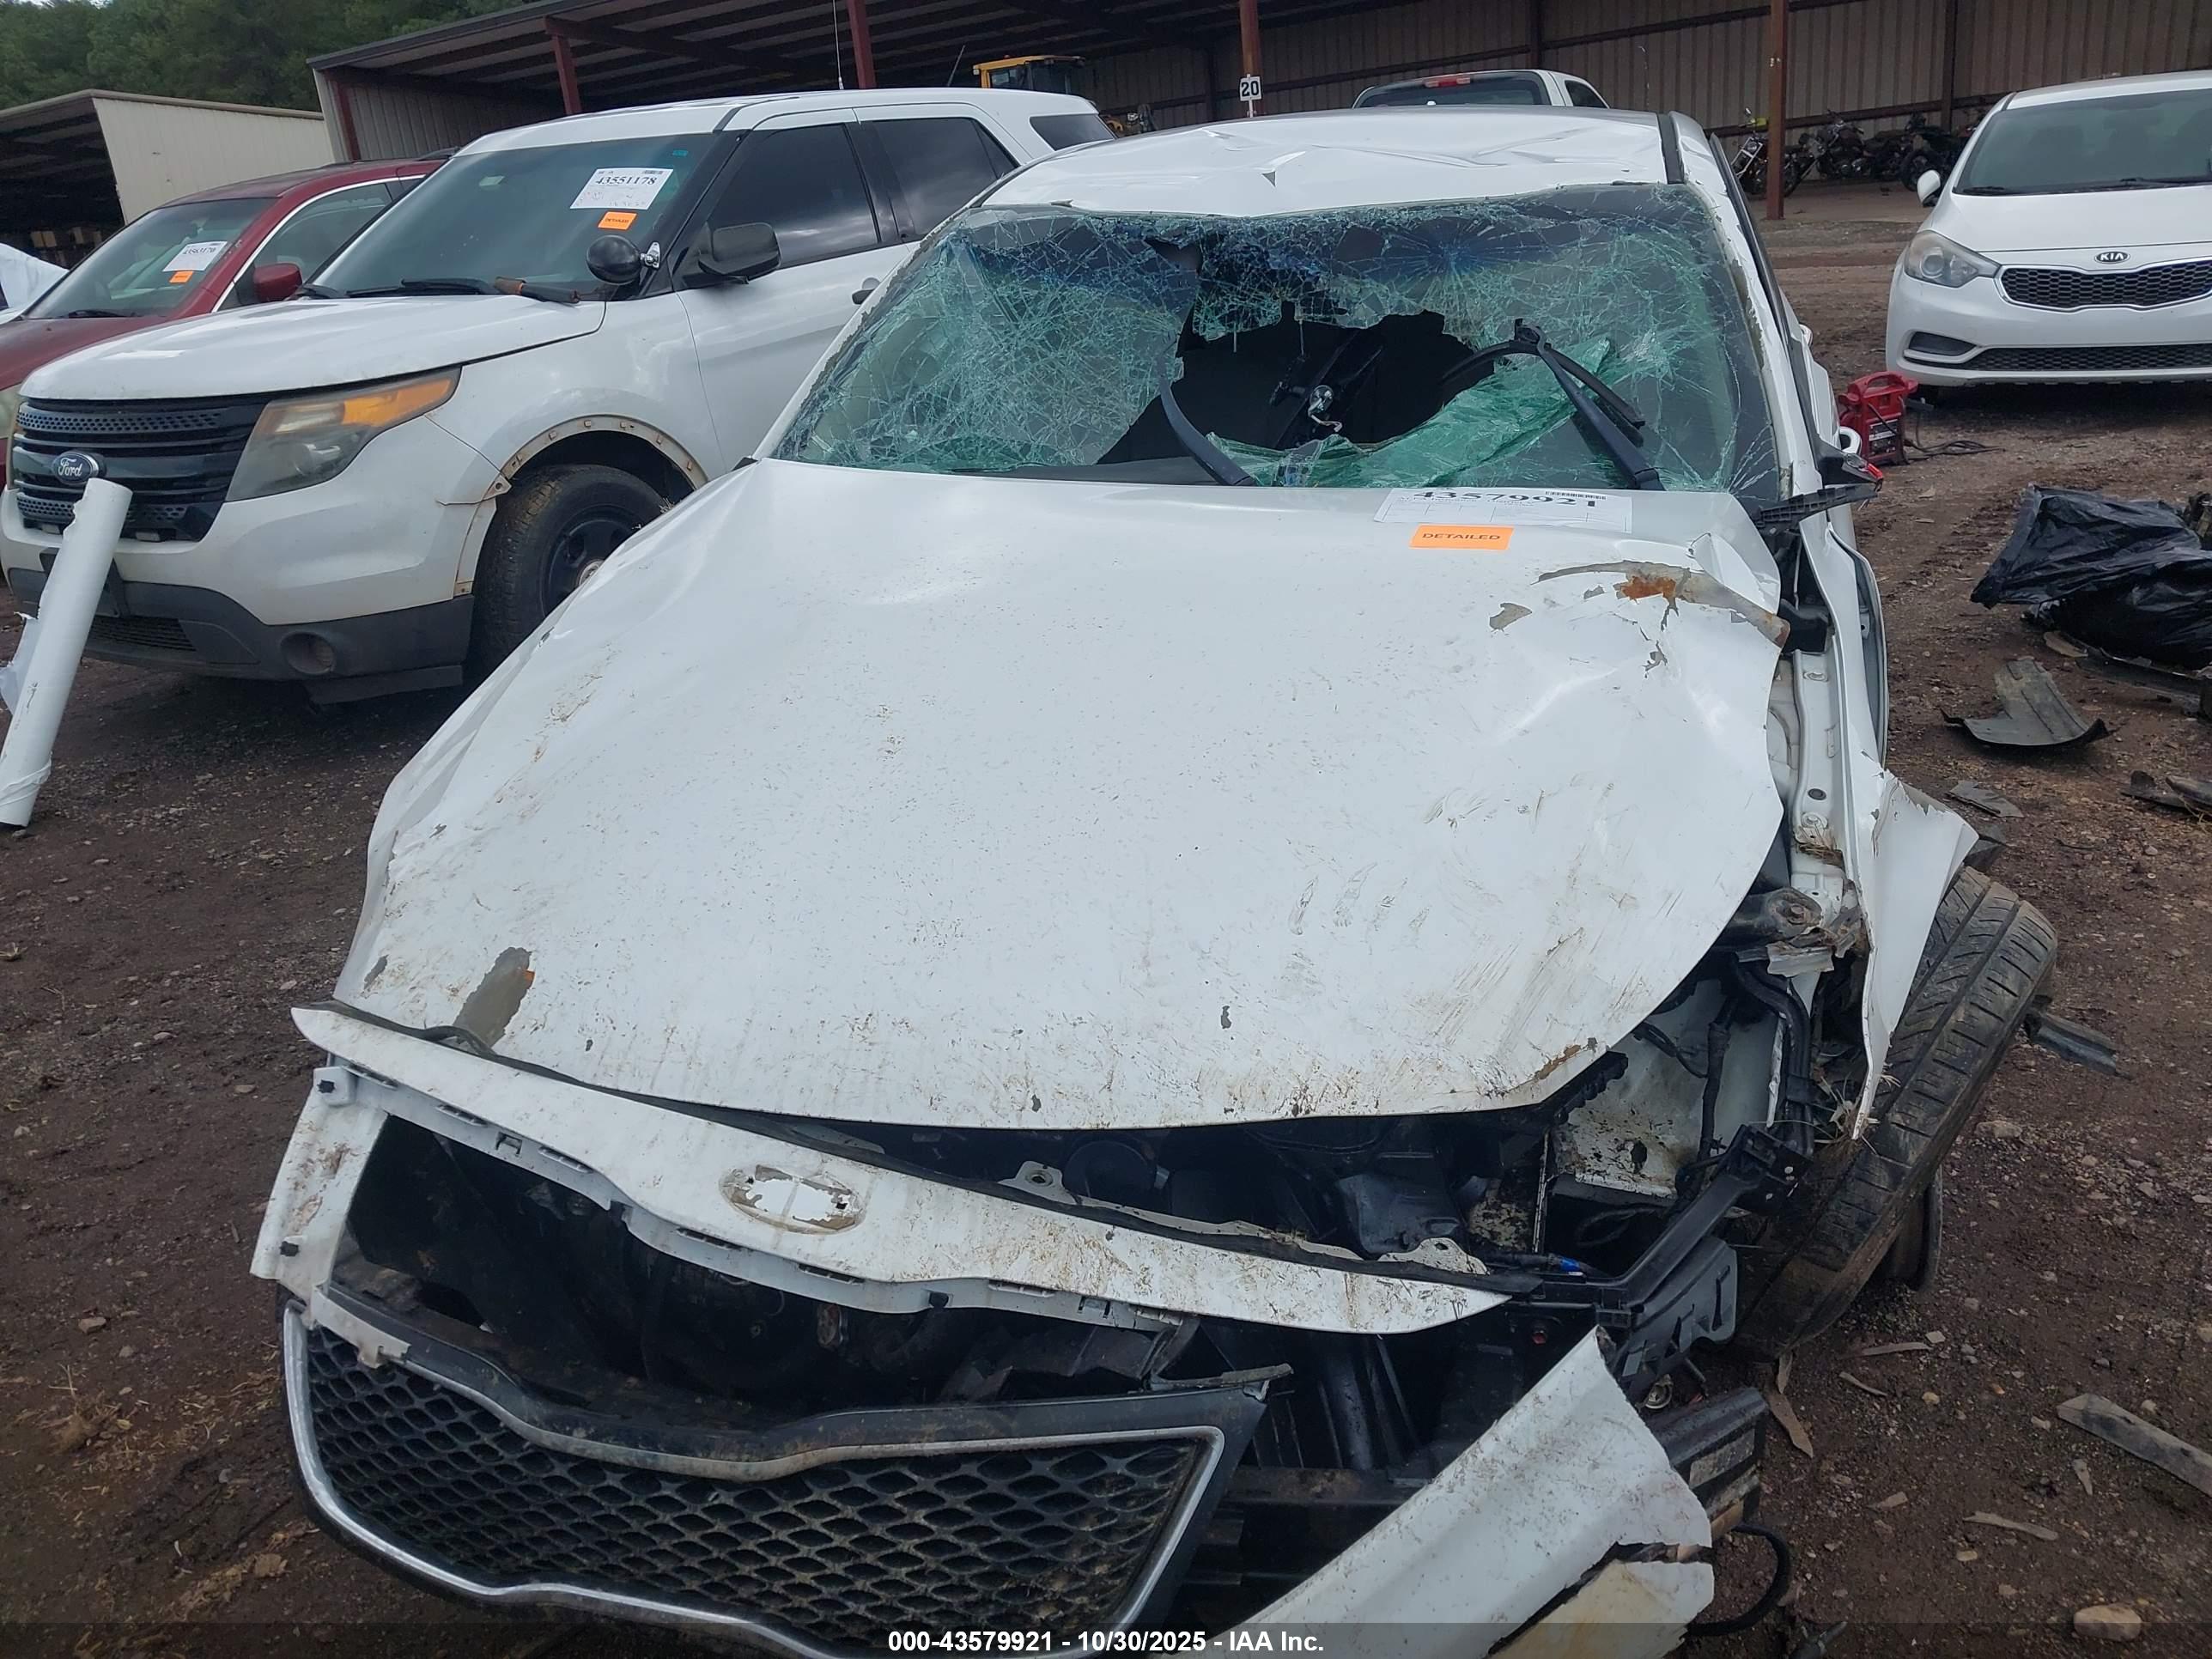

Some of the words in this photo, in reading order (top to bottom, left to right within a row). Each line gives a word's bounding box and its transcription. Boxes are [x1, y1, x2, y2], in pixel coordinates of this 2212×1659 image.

[1241, 81, 1260, 97] 20
[595, 176, 658, 185] 43551178
[2100, 252, 2124, 261] KIA
[58, 457, 83, 477] Ford
[1413, 491, 1596, 508] 43579921
